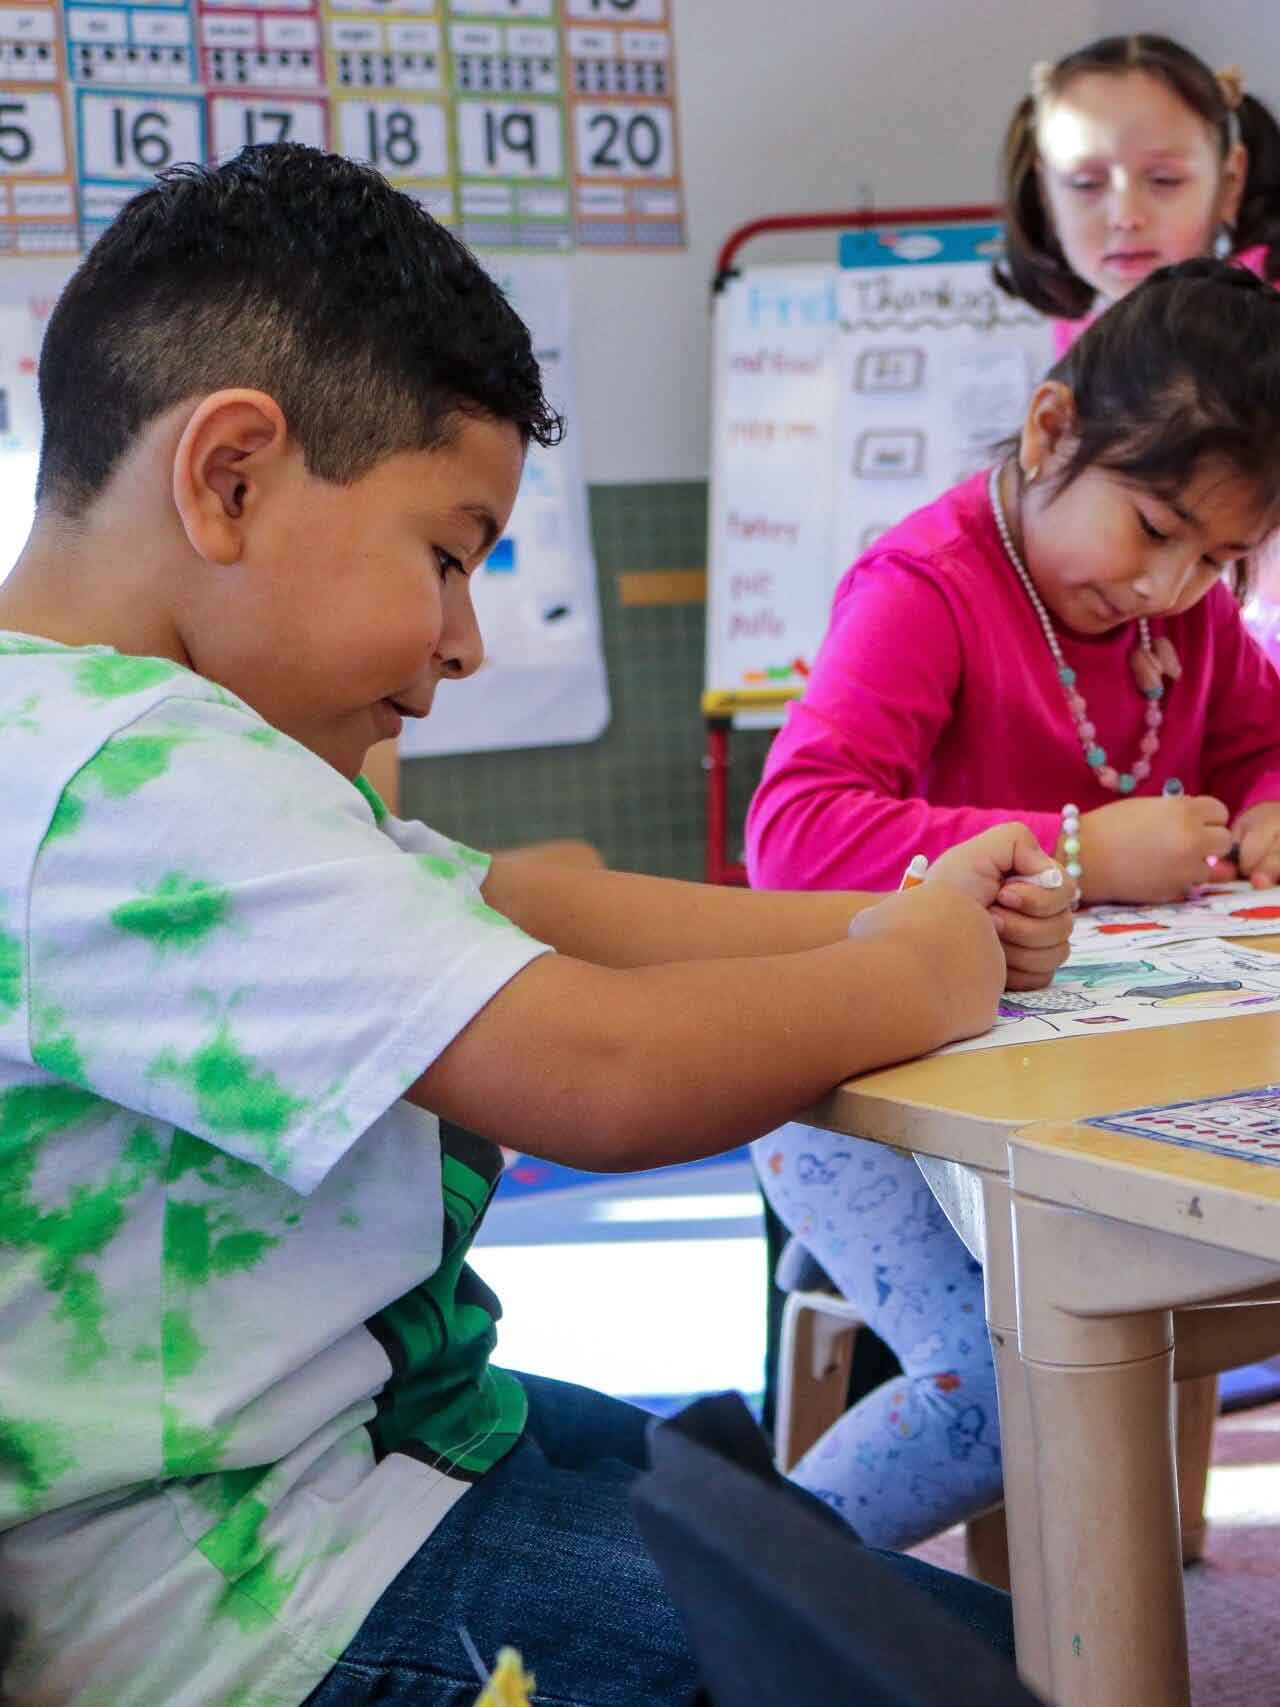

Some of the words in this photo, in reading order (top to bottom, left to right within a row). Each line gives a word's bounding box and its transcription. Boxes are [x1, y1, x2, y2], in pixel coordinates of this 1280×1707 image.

[113, 107, 172, 168] 16
[244, 109, 294, 144] 17
[368, 109, 421, 167] 18
[485, 110, 536, 168] 19
[588, 112, 662, 168] 20
